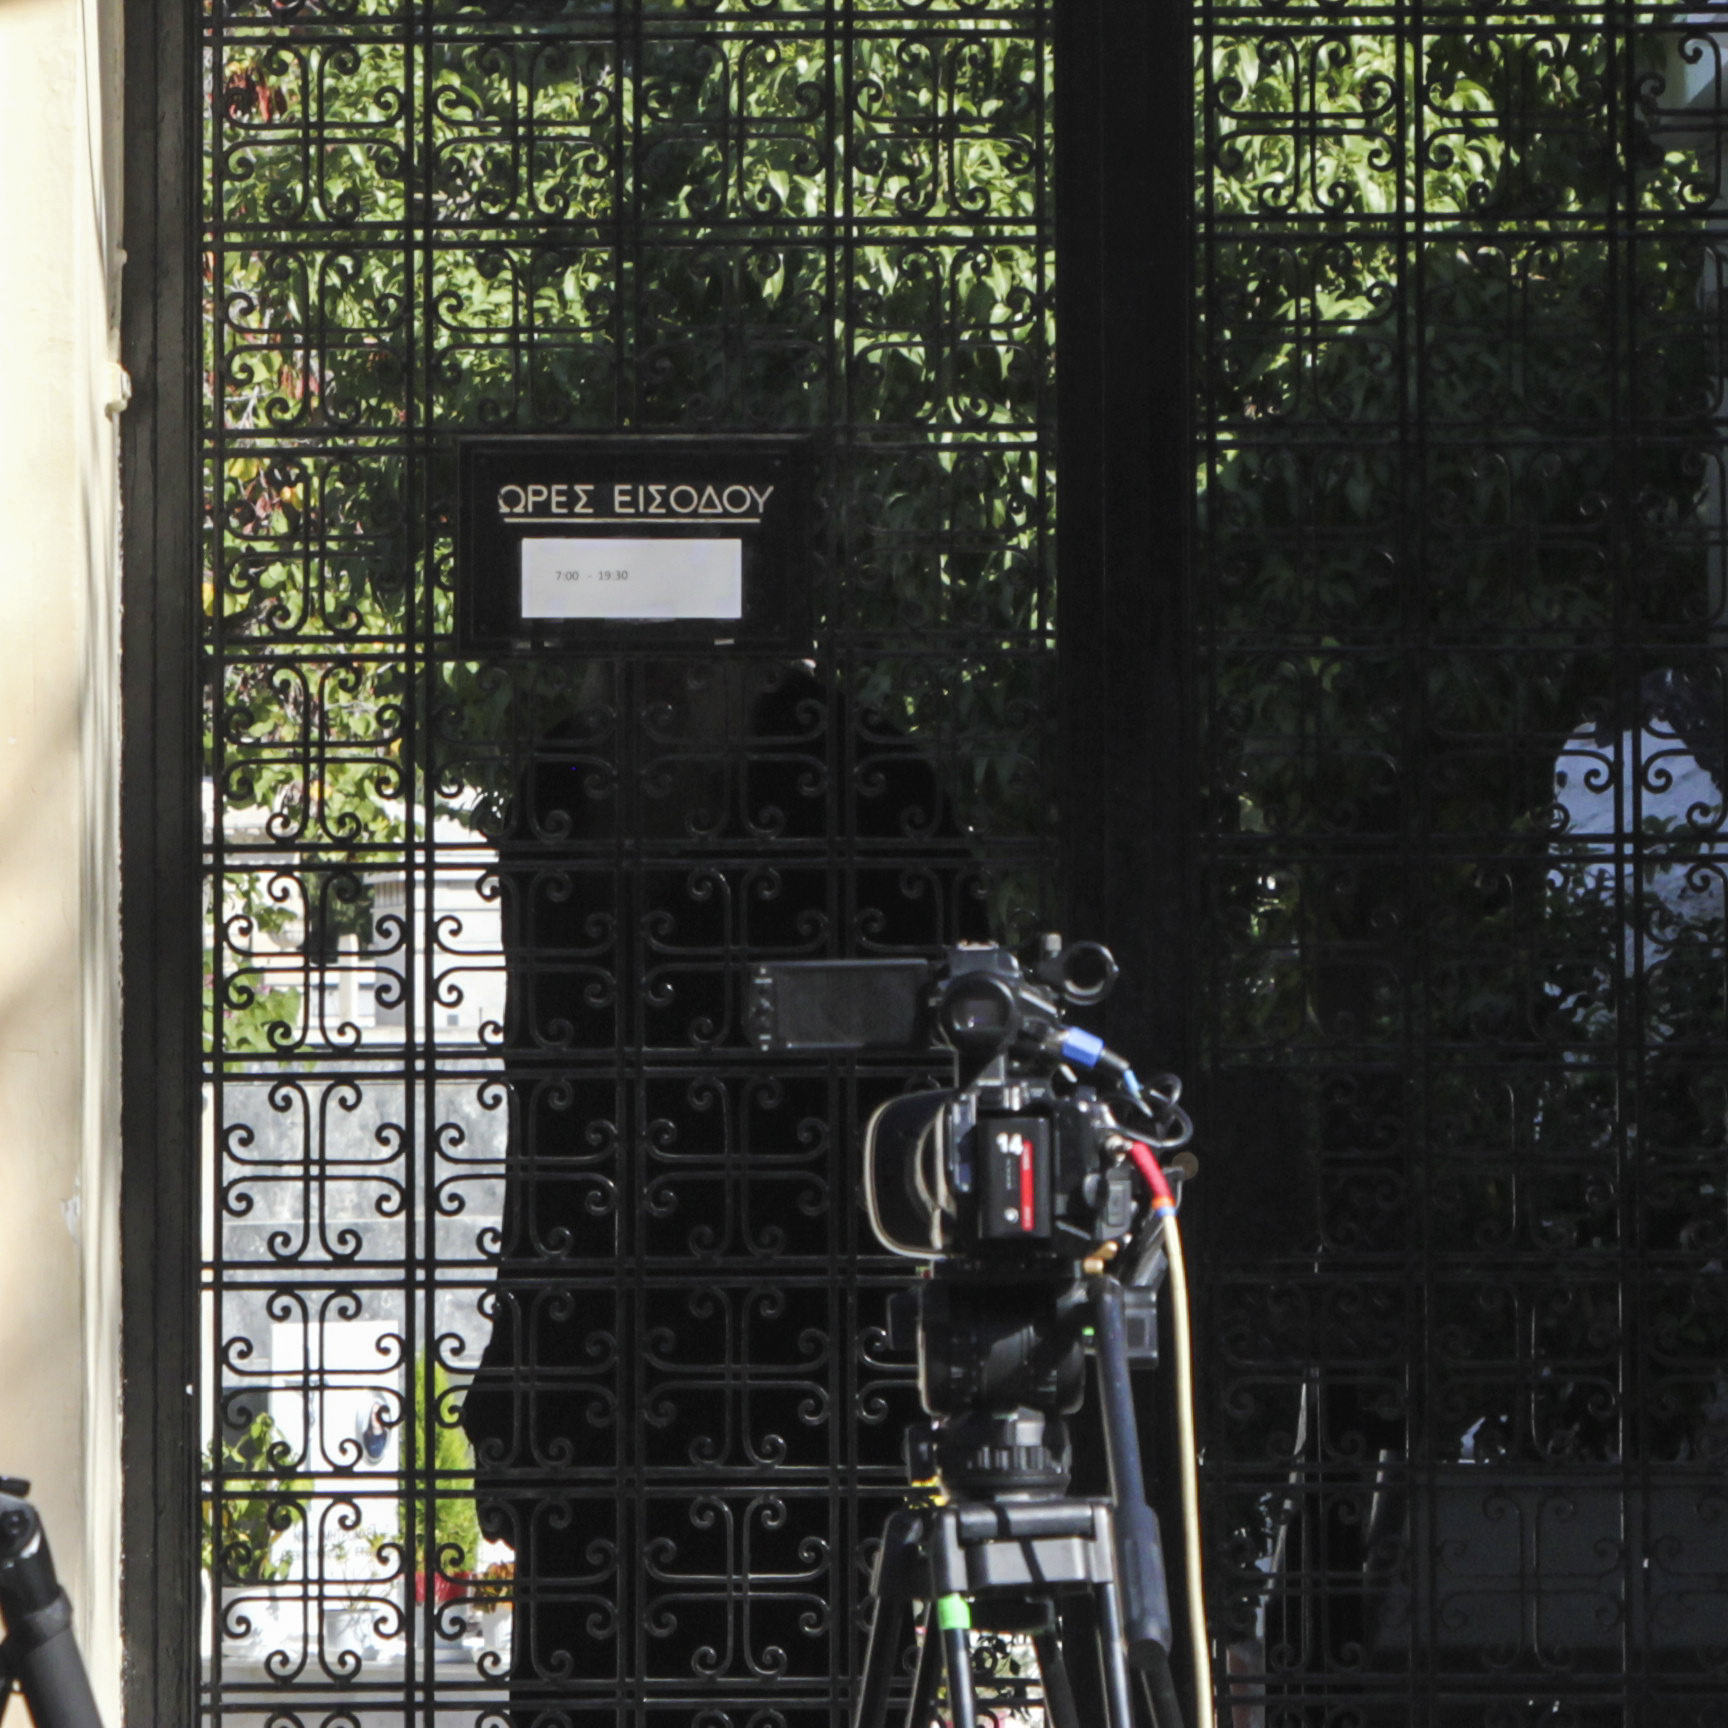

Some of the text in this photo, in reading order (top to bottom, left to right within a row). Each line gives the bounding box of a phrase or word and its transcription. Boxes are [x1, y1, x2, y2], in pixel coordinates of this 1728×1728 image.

[497, 484, 774, 514] ΩΡΕΣ ΕΙΣΟΔΟΥ
[996, 1132, 1024, 1156] 14
